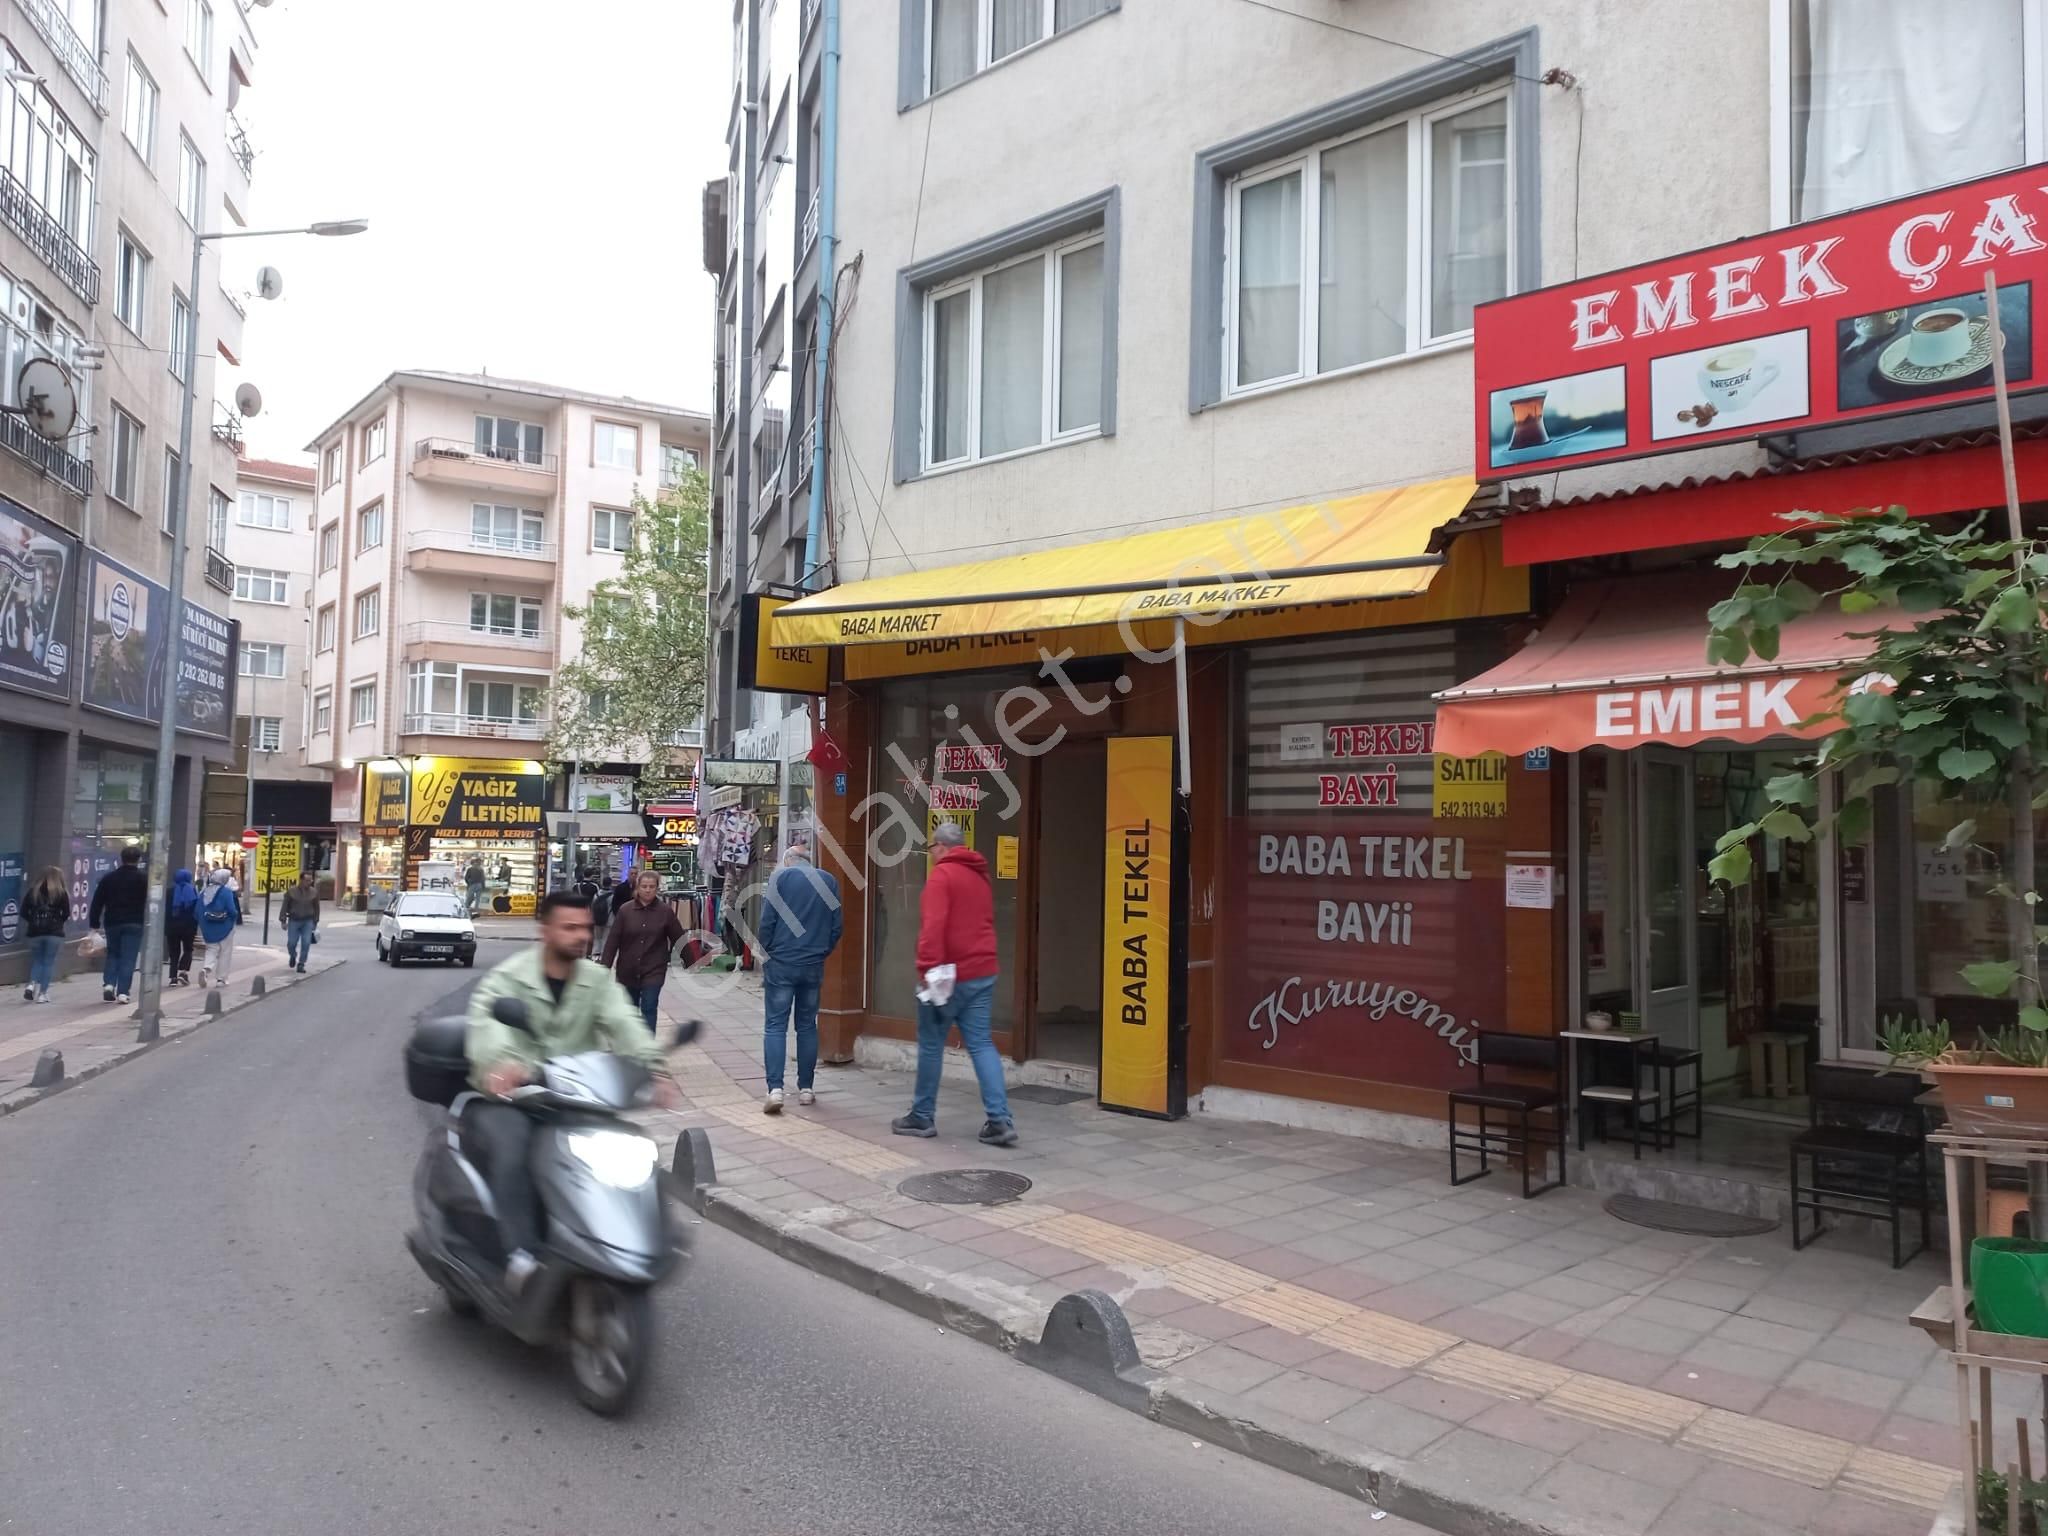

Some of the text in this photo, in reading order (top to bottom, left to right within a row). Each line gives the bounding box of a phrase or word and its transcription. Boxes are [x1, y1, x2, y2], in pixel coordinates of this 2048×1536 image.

[1570, 187, 2048, 350] EMEK ÇA
[1138, 584, 1291, 609] BABA MARKET
[841, 613, 941, 636] BABA MARKET
[775, 647, 813, 663] TEKEL
[1596, 678, 1802, 737] EMEK
[935, 744, 1008, 773] TEKEL
[461, 776, 517, 797] YAĞIZ
[929, 777, 979, 810] BAYİ
[1318, 763, 1399, 806] BAYİ
[461, 801, 541, 823] İLETİŞİM
[1441, 802, 1460, 818] 542
[434, 829, 461, 837] HIZLI
[1258, 834, 1473, 880] BABA TEKEL
[1121, 818, 1150, 1026] BABA TEKEL
